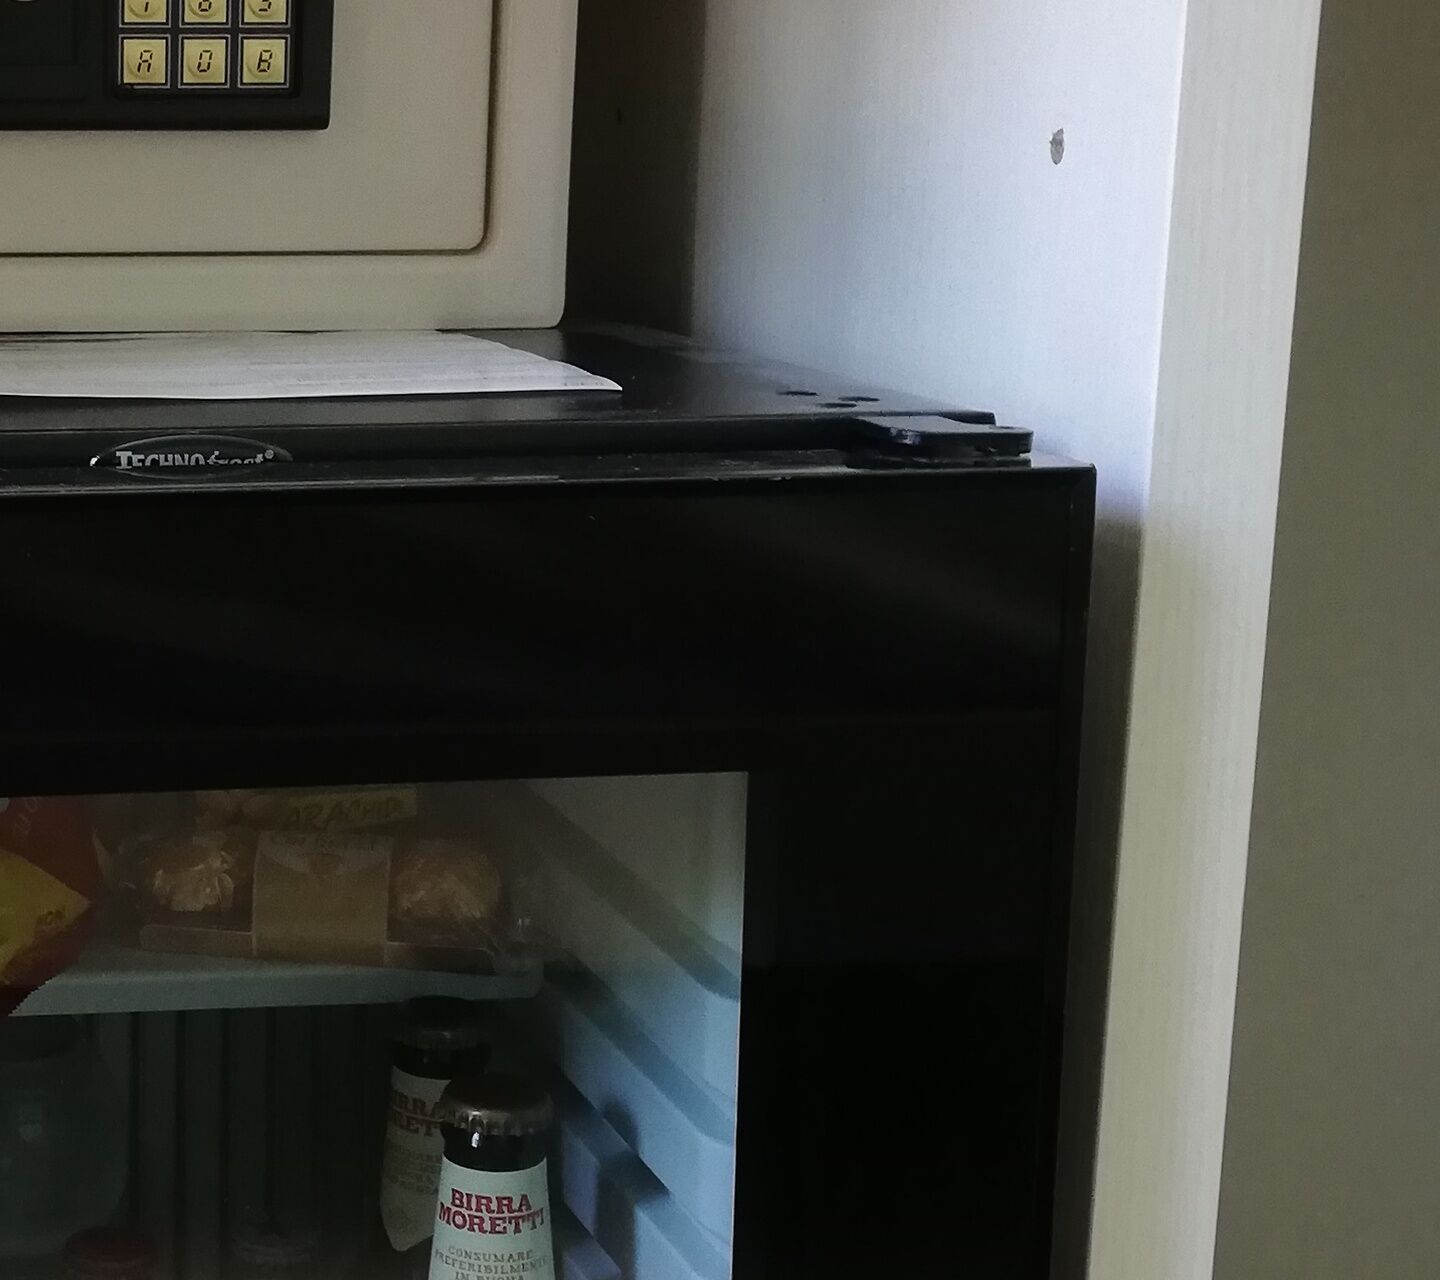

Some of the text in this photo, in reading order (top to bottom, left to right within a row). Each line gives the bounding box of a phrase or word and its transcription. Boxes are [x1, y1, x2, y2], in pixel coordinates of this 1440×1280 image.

[137, 50, 153, 73] A
[451, 1188, 532, 1215] BIRRA
[439, 1202, 544, 1235] MORETTI
[448, 1246, 535, 1264] CONSUMARE
